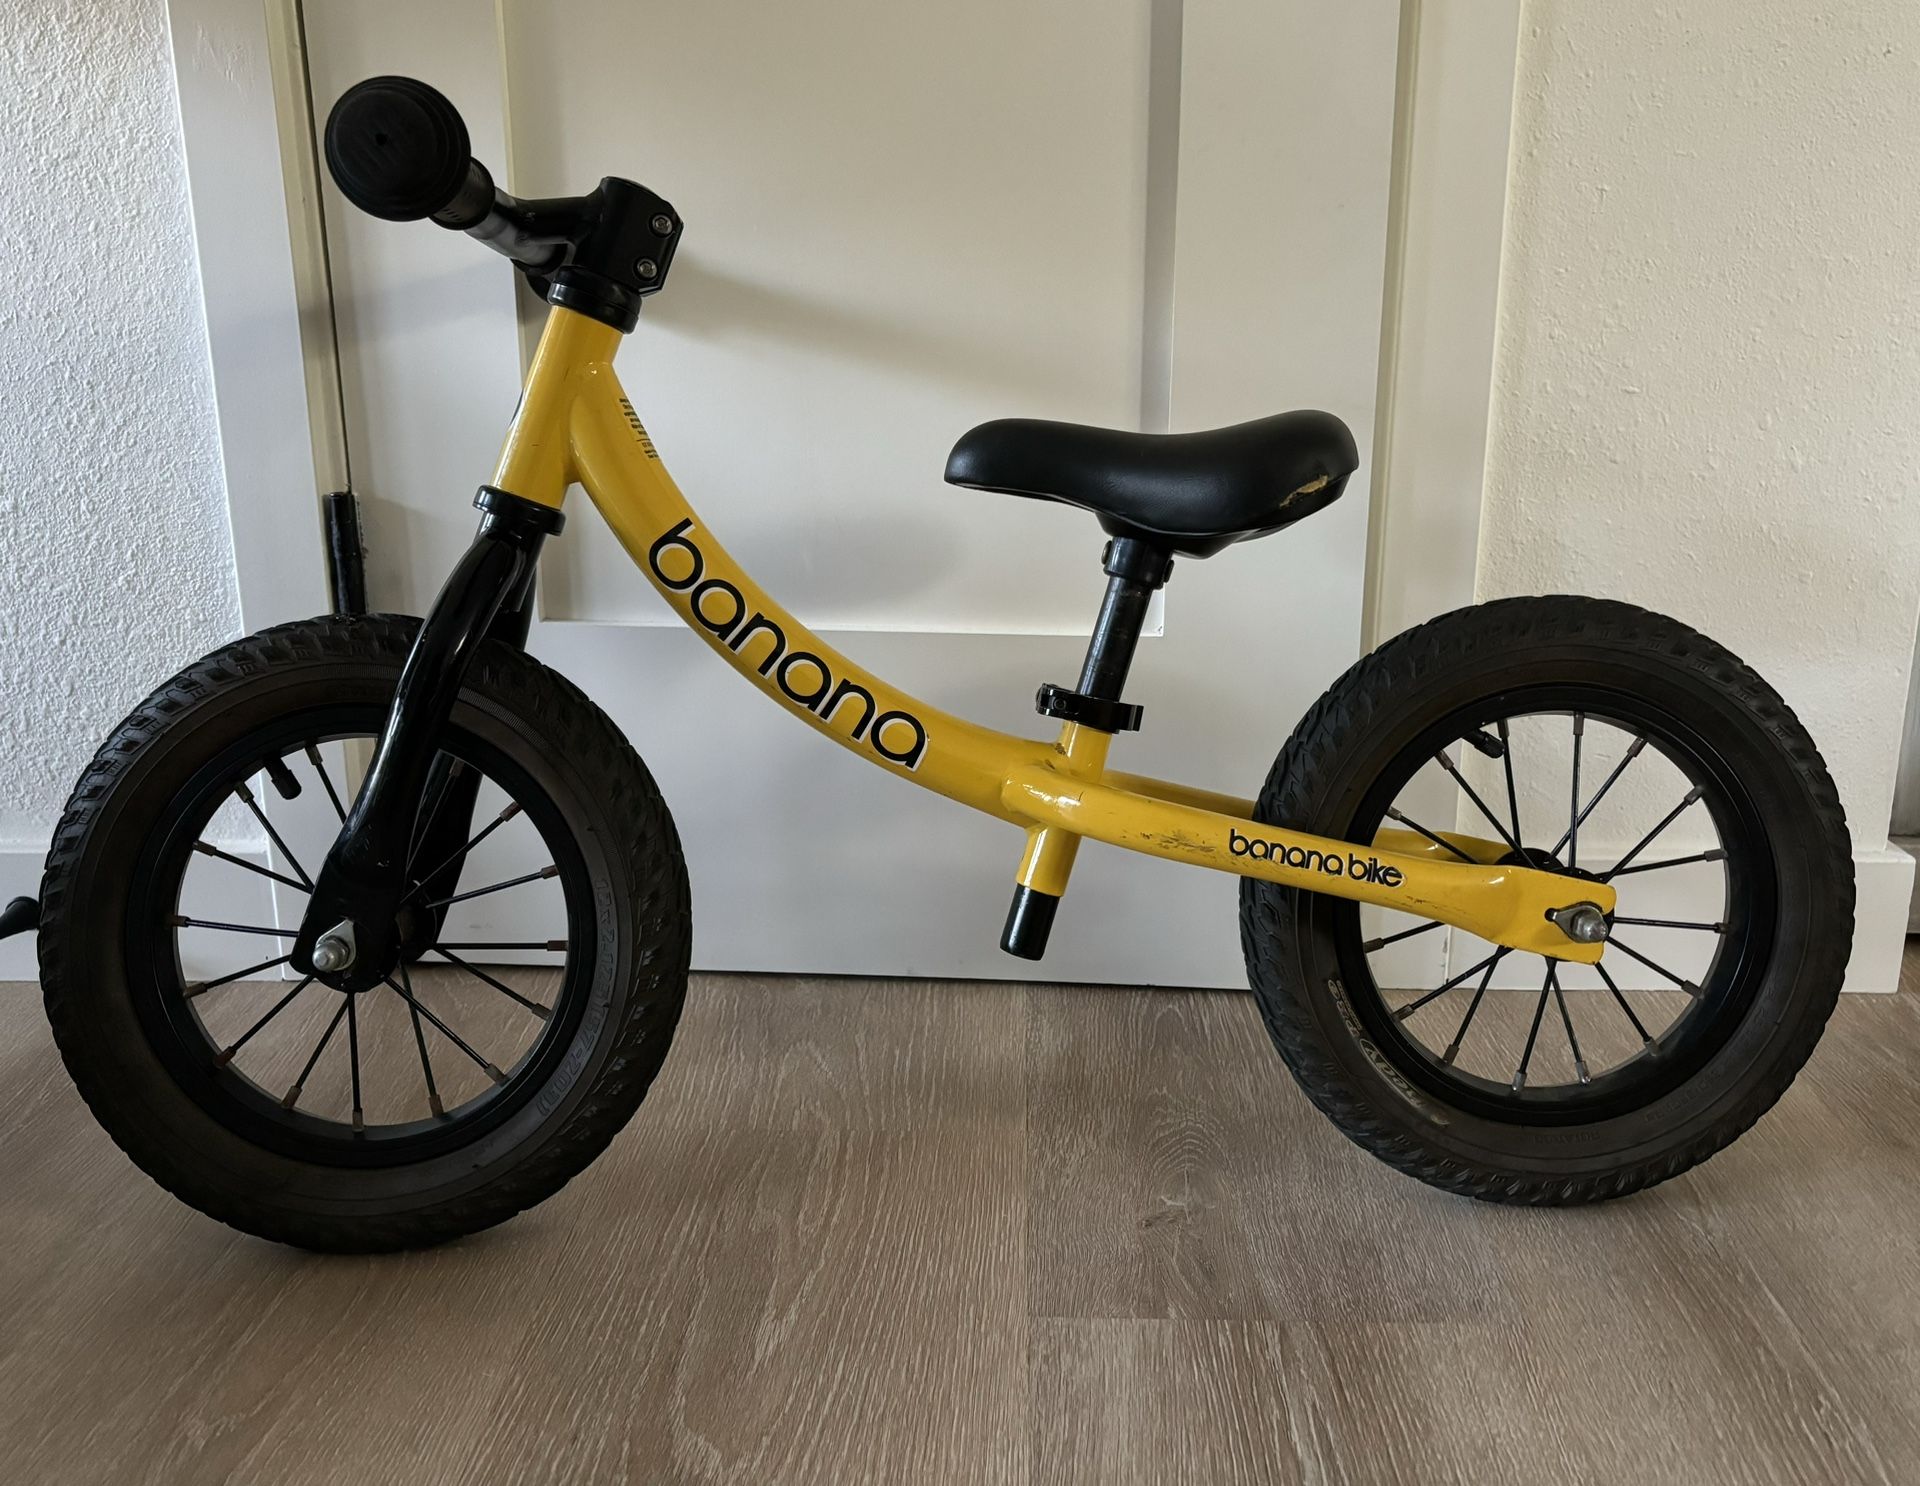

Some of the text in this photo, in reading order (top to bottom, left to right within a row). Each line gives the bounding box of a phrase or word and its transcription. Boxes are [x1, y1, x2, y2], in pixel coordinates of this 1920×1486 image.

[648, 517, 926, 770] banana
[1229, 828, 1403, 888] banana bike
